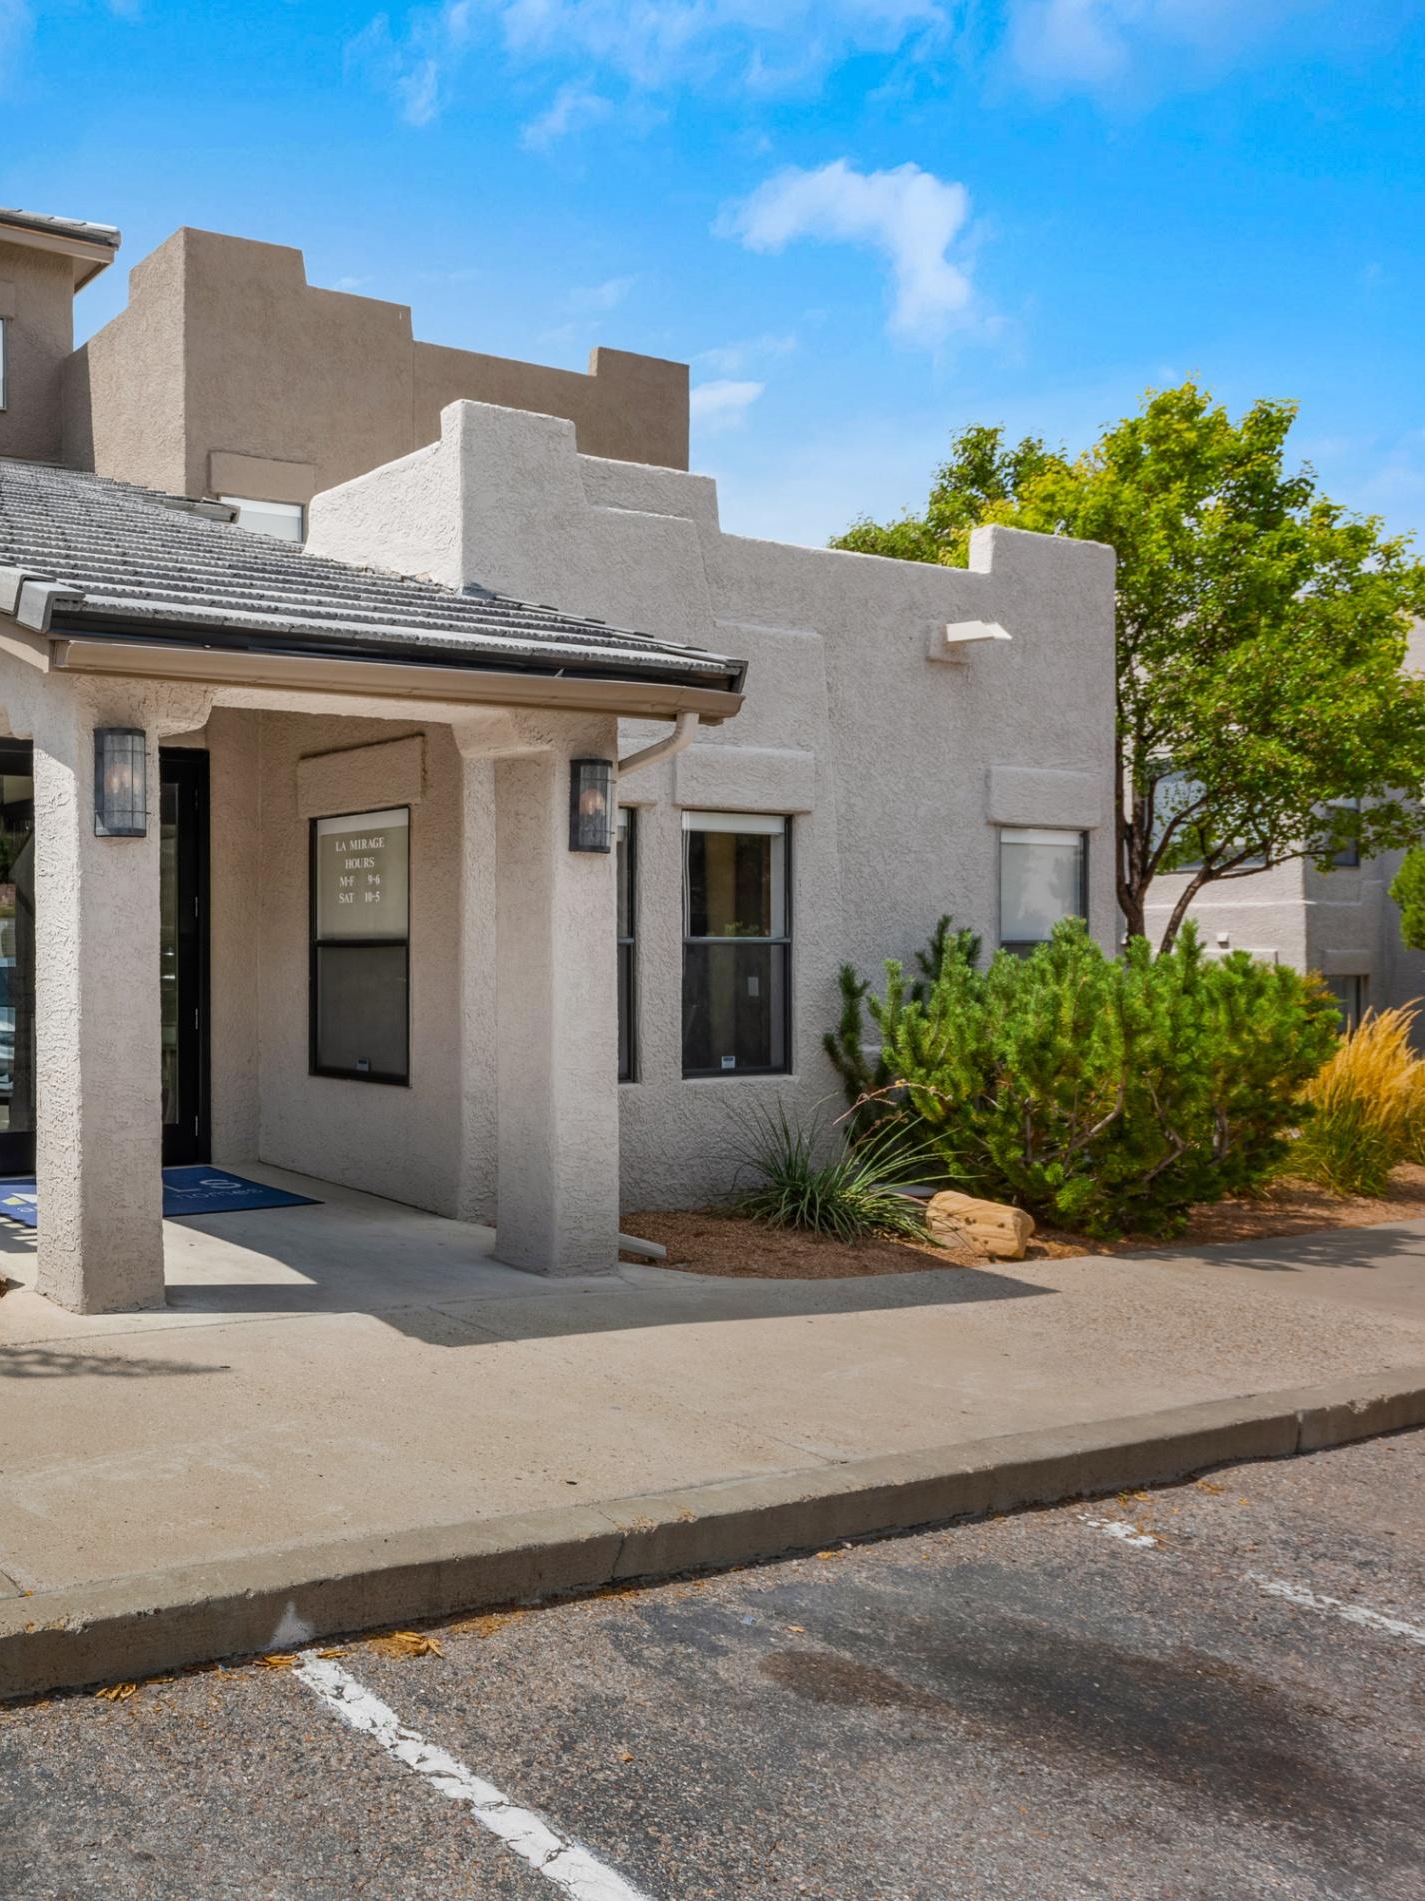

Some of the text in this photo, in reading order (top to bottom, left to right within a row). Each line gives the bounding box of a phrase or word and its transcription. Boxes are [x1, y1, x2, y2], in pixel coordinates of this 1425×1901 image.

[335, 837, 385, 852] LA MIRAGE
[345, 857, 375, 870] HOURS
[339, 875, 355, 887] M-F
[339, 892, 354, 904] SAT
